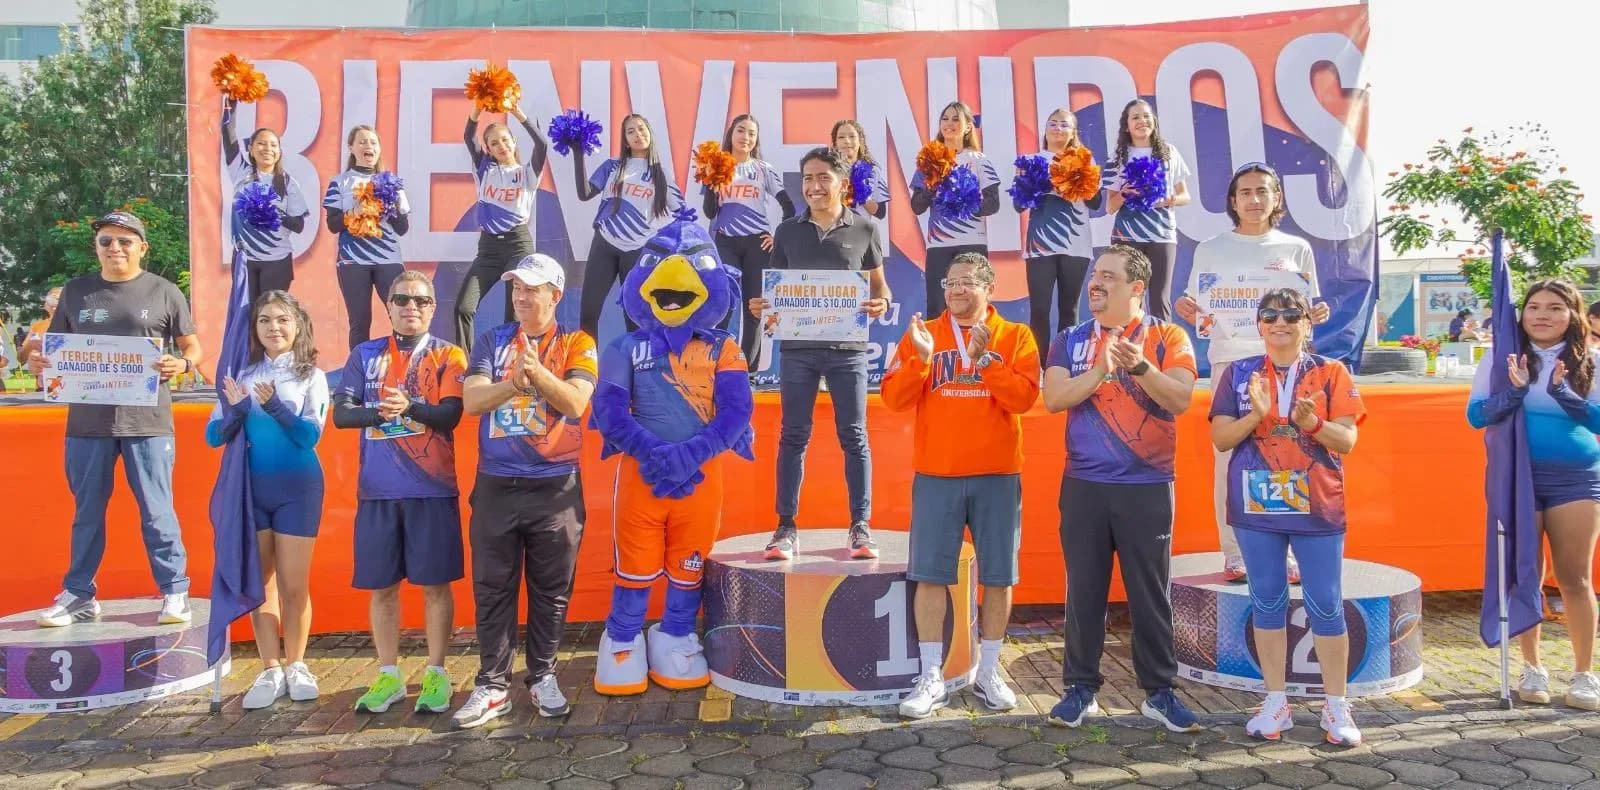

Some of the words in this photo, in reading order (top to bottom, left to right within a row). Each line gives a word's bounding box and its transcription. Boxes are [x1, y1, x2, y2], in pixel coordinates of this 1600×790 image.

[222, 33, 1378, 265] BIENVENIDOS
[775, 285, 817, 298] PRIMER
[821, 285, 857, 298] LUGAR
[1210, 288, 1259, 299] SEGUNDO
[774, 298, 810, 308] GANADOR
[812, 298, 822, 308] DE
[823, 298, 857, 309] $10,000
[1209, 299, 1248, 309] GANADOR
[61, 351, 103, 363] TERCER
[107, 352, 144, 364] LUGAR
[57, 361, 97, 373] GANADOR
[100, 363, 111, 373] DE
[121, 364, 144, 374] 5000
[364, 381, 385, 389] nter
[501, 407, 536, 426] 317
[1258, 482, 1295, 500] 121
[874, 580, 920, 677] 1
[50, 650, 73, 692] 3
